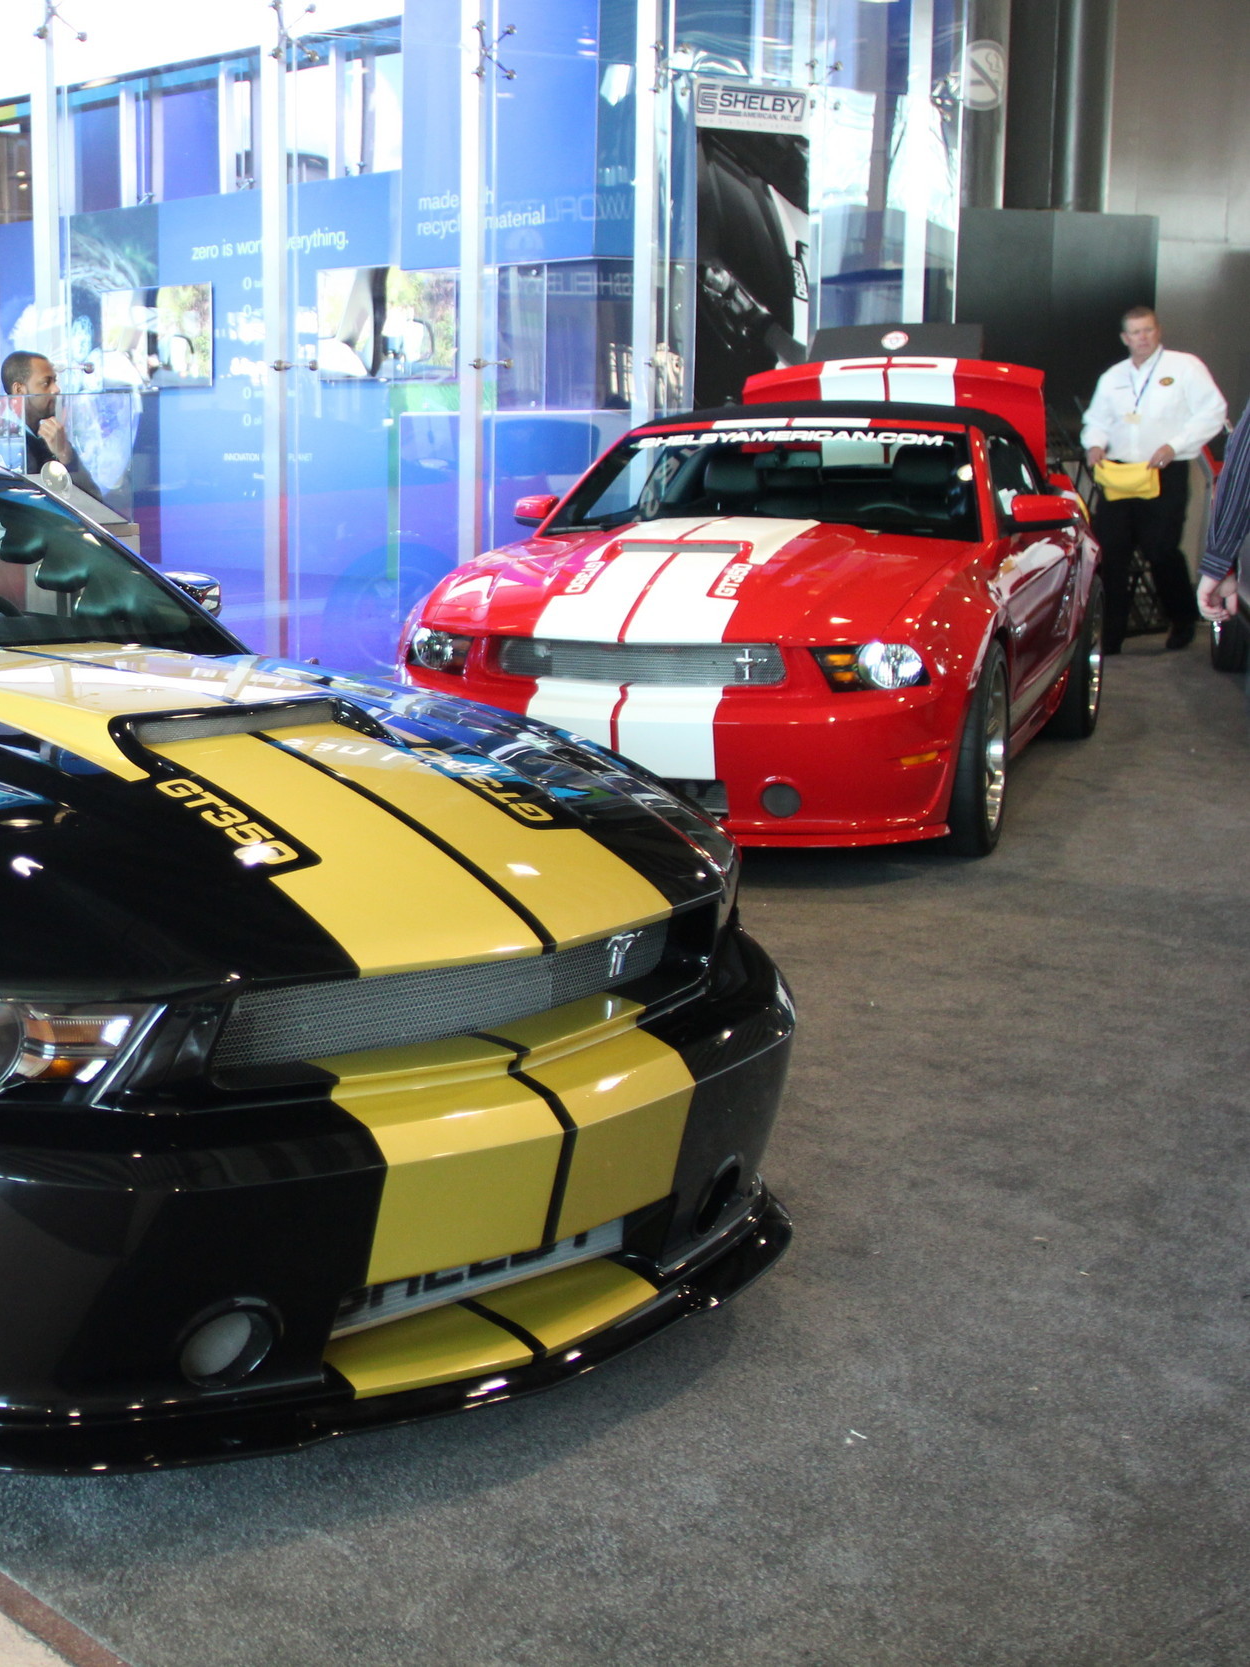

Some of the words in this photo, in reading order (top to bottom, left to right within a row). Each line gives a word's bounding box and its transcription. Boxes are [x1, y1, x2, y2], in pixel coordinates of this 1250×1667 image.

[719, 92, 801, 114] SHELBY
[418, 190, 460, 212] made
[417, 214, 461, 240] recycl
[485, 204, 546, 230] material
[191, 245, 219, 261] zero
[222, 238, 234, 257] is
[236, 239, 264, 256] wor
[286, 227, 349, 254] verything.
[636, 430, 945, 449] SHELBYAMERICAN.COM
[564, 560, 606, 594] GT350
[713, 563, 754, 598] GT350
[155, 777, 299, 866] GT350
